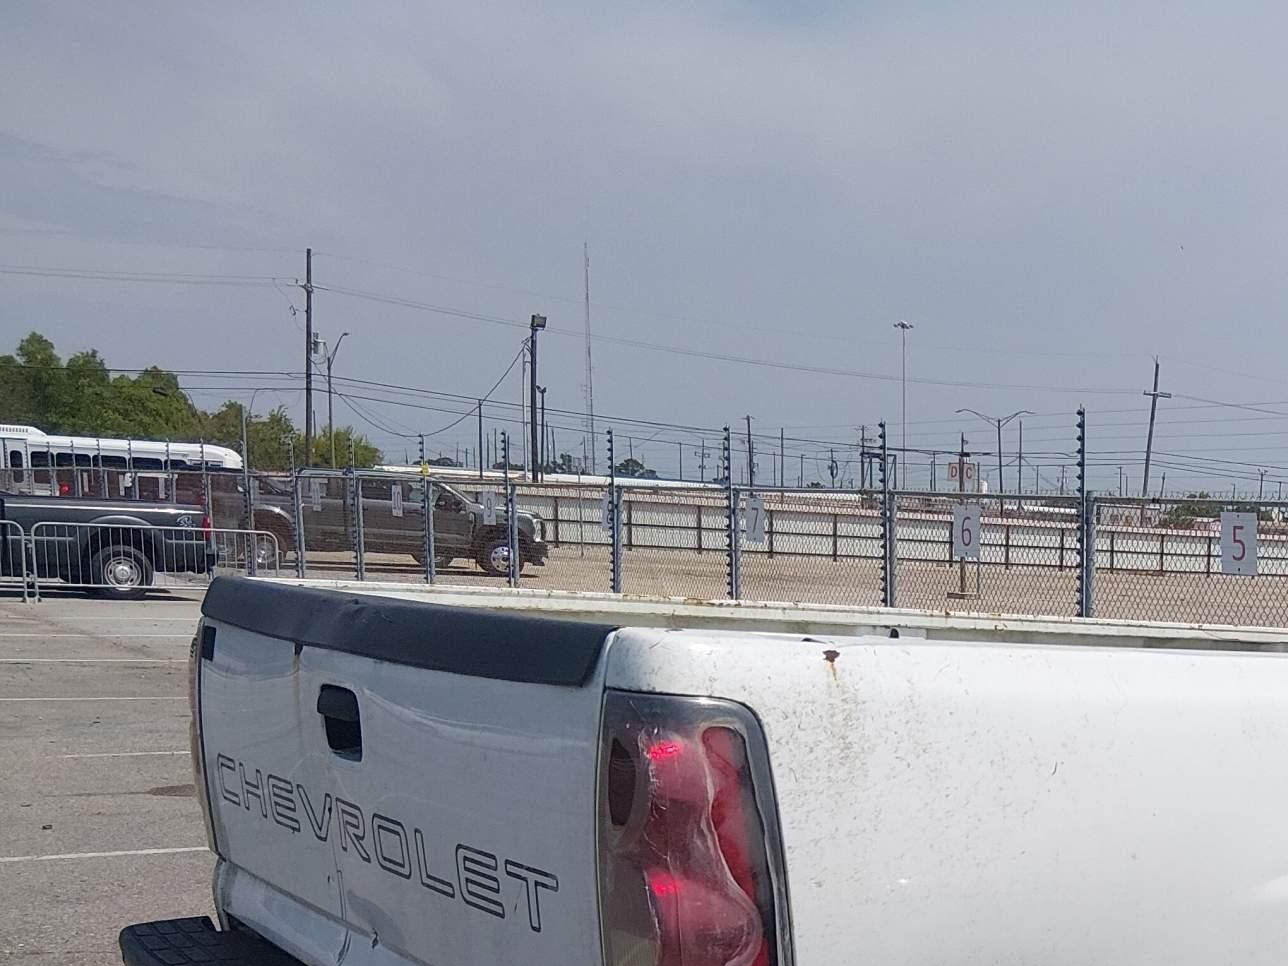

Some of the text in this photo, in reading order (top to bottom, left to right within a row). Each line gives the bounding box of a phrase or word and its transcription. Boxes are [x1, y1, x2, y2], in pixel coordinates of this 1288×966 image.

[950, 465, 958, 478] D
[965, 466, 973, 479] C
[751, 507, 759, 533] 7
[961, 516, 972, 546] 6
[1232, 525, 1246, 561] 5
[217, 751, 559, 933] CHEVROLET
